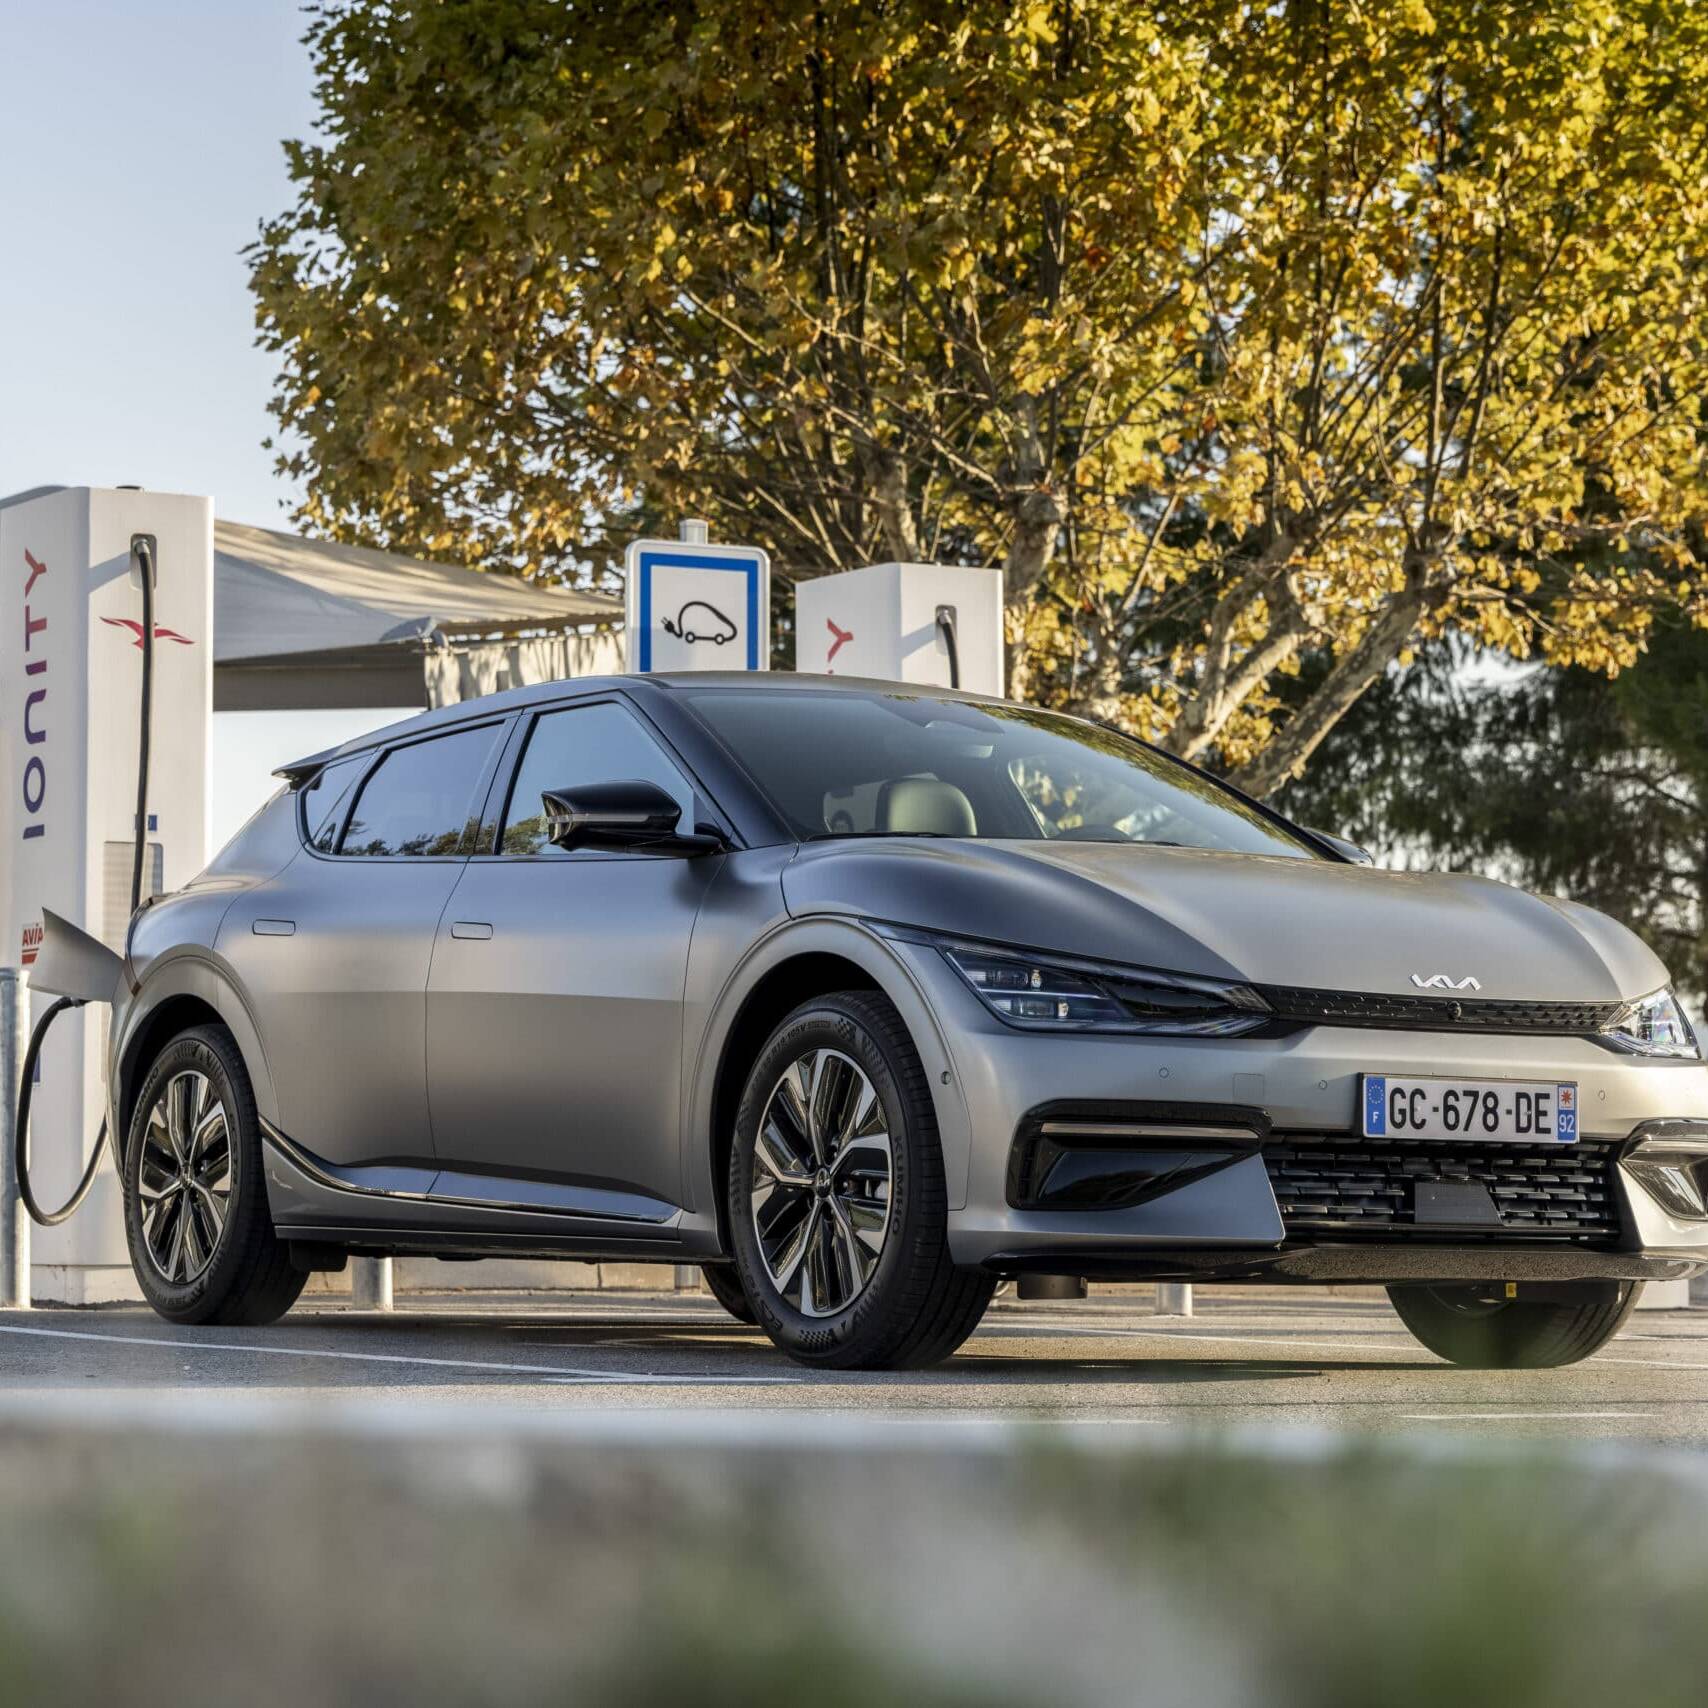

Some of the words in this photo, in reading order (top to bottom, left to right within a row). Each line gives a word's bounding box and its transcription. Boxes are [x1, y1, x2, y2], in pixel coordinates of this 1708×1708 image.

[23, 548, 47, 840] IONITY
[1372, 1111, 1380, 1124] F
[1389, 1087, 1552, 1135] GC-678-DE
[1558, 1114, 1575, 1134] 92
